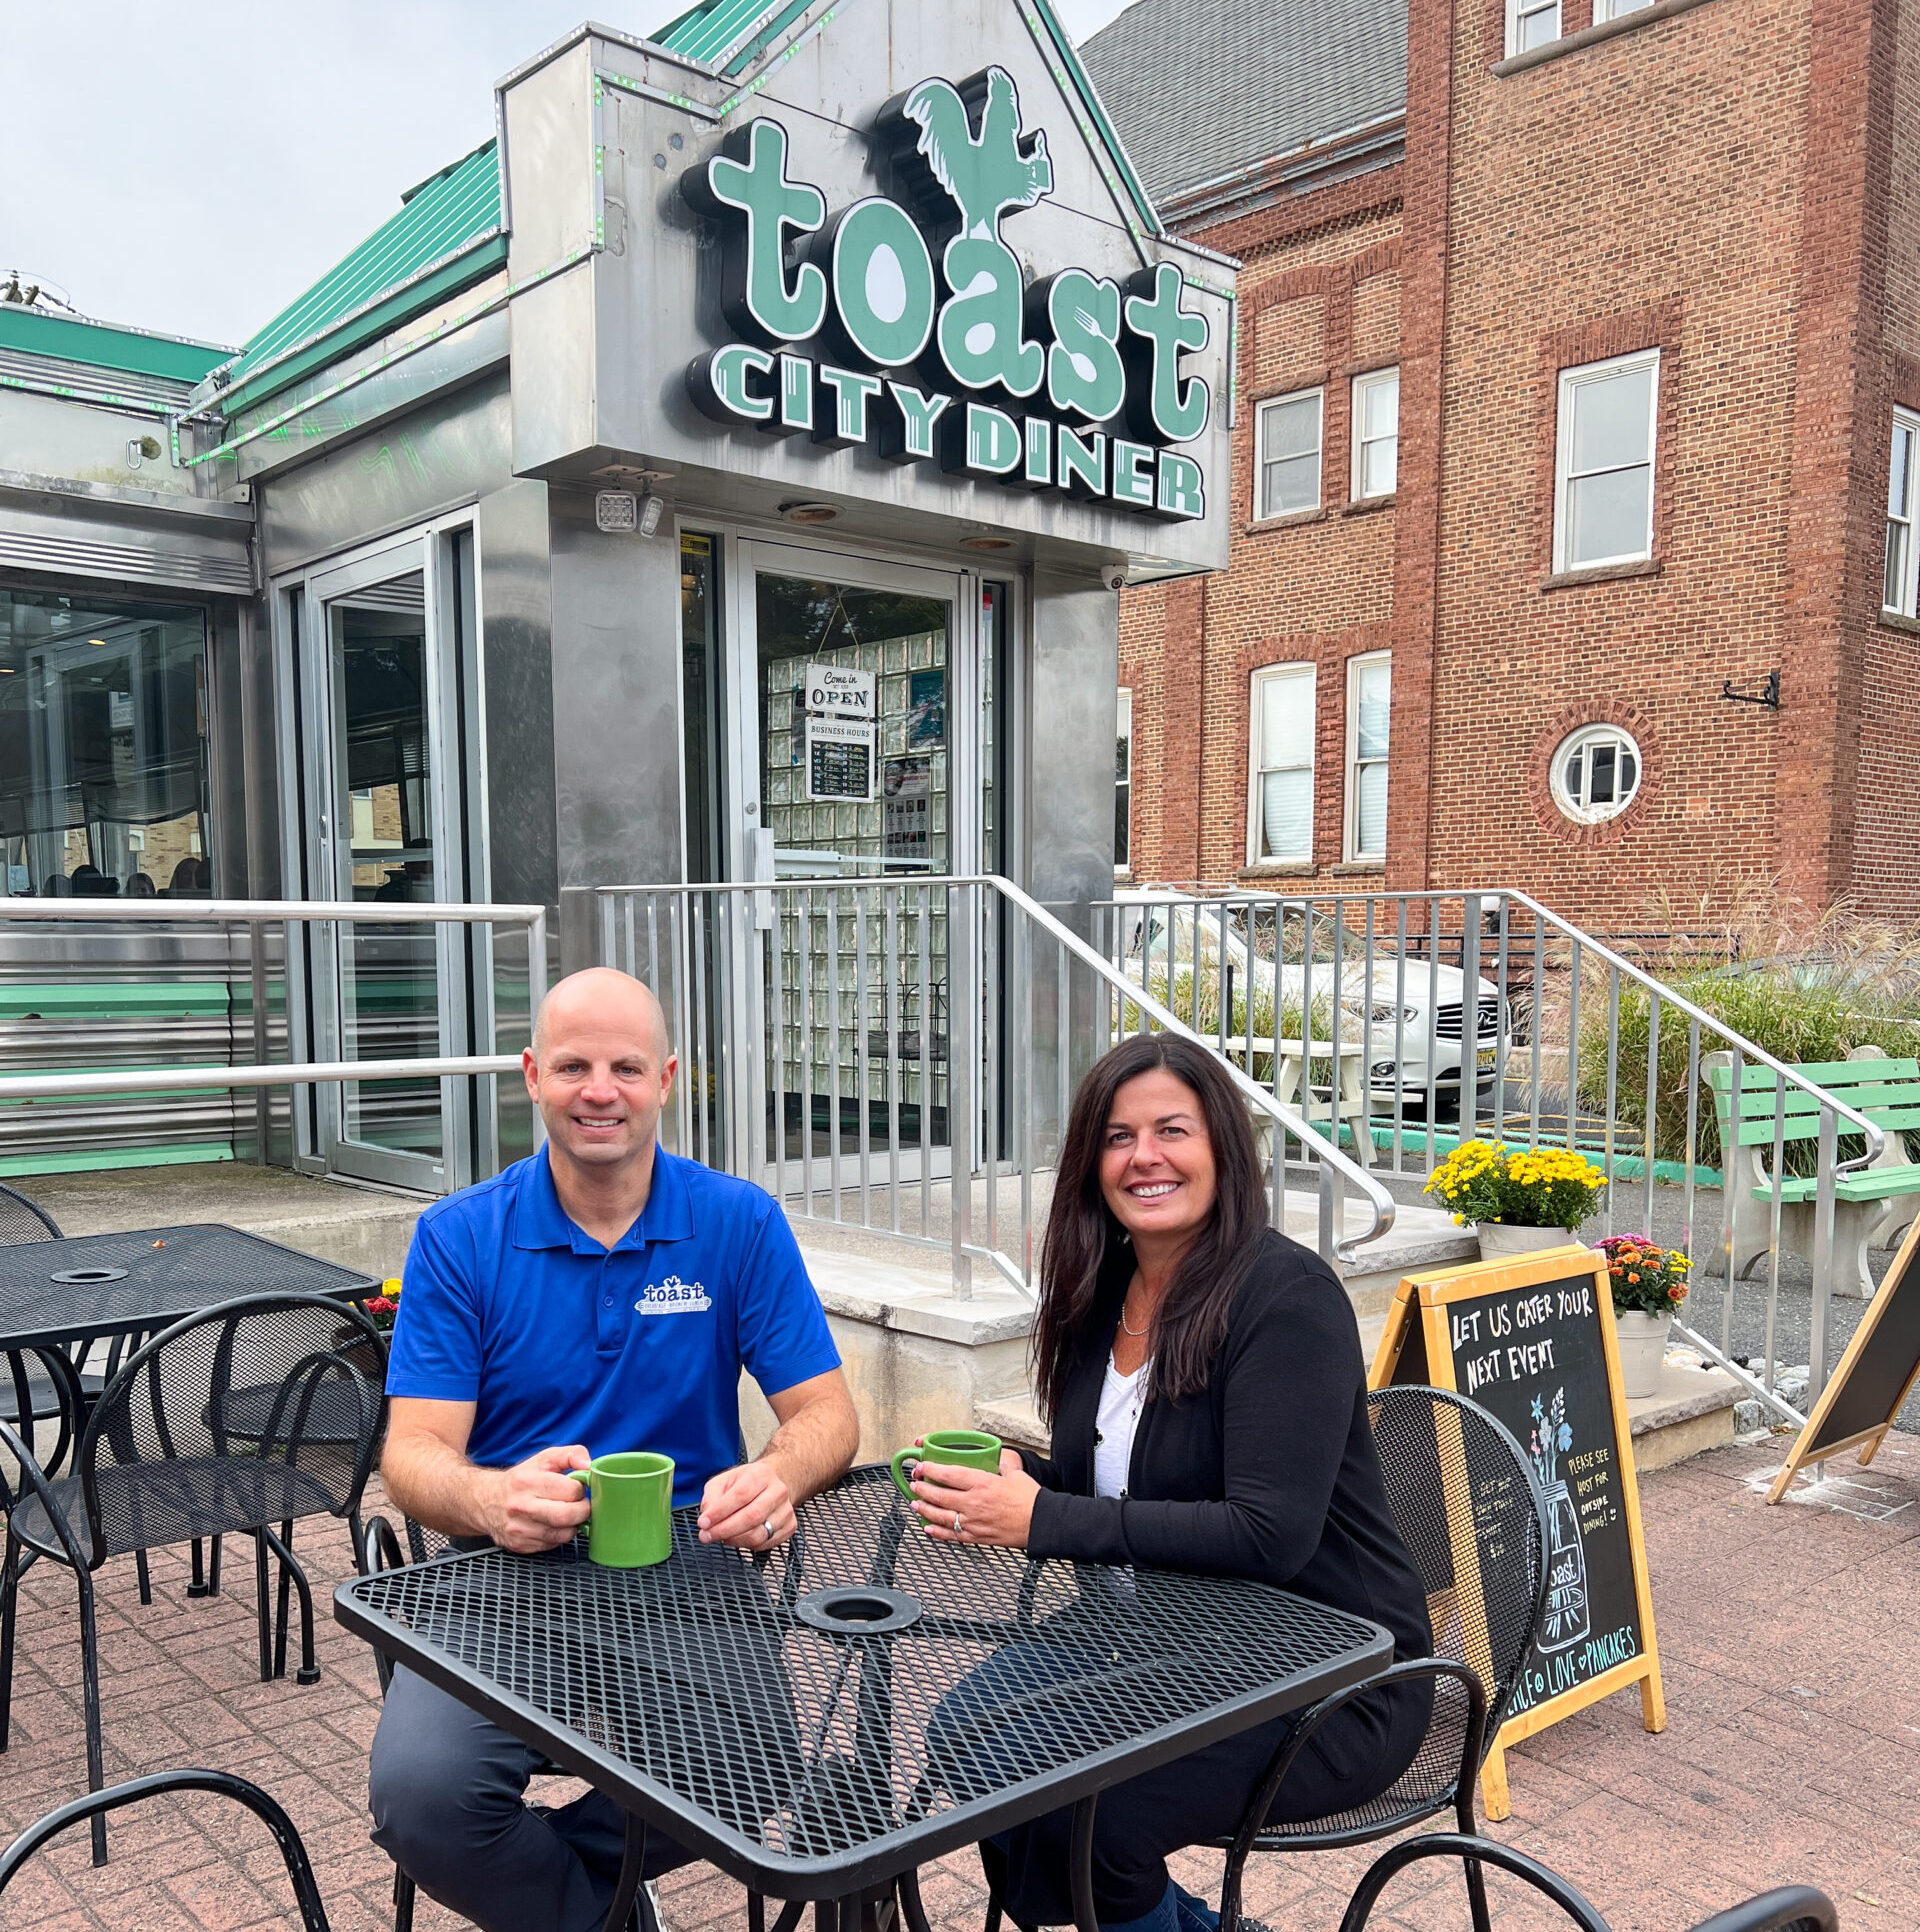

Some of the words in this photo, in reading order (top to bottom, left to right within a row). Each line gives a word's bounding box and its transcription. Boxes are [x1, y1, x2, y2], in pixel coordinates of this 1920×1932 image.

[708, 116, 1209, 443] toast
[709, 343, 952, 458] CITY
[966, 401, 1206, 520] DINER
[824, 671, 847, 685] Come
[848, 673, 858, 684] in
[812, 688, 870, 708] OPEN
[811, 725, 845, 736] BUSINESS
[846, 728, 870, 738] HOURS
[645, 1283, 704, 1303] toast
[1453, 1310, 1481, 1351] LET
[1489, 1303, 1512, 1337] US
[1516, 1294, 1554, 1329] CATER
[1557, 1287, 1593, 1320] YOUR
[1466, 1349, 1501, 1396] NEXT
[1507, 1338, 1555, 1381] EVENT
[1568, 1452, 1594, 1476] PLEASE
[1595, 1448, 1610, 1468] SEE
[1577, 1476, 1594, 1497] HOST
[1581, 1495, 1609, 1516] OUTSIDE
[1582, 1510, 1608, 1535] DINING!
[1551, 1553, 1577, 1587] oast
[1546, 1650, 1580, 1696] LOVE
[1586, 1625, 1636, 1677] PANCAKES
